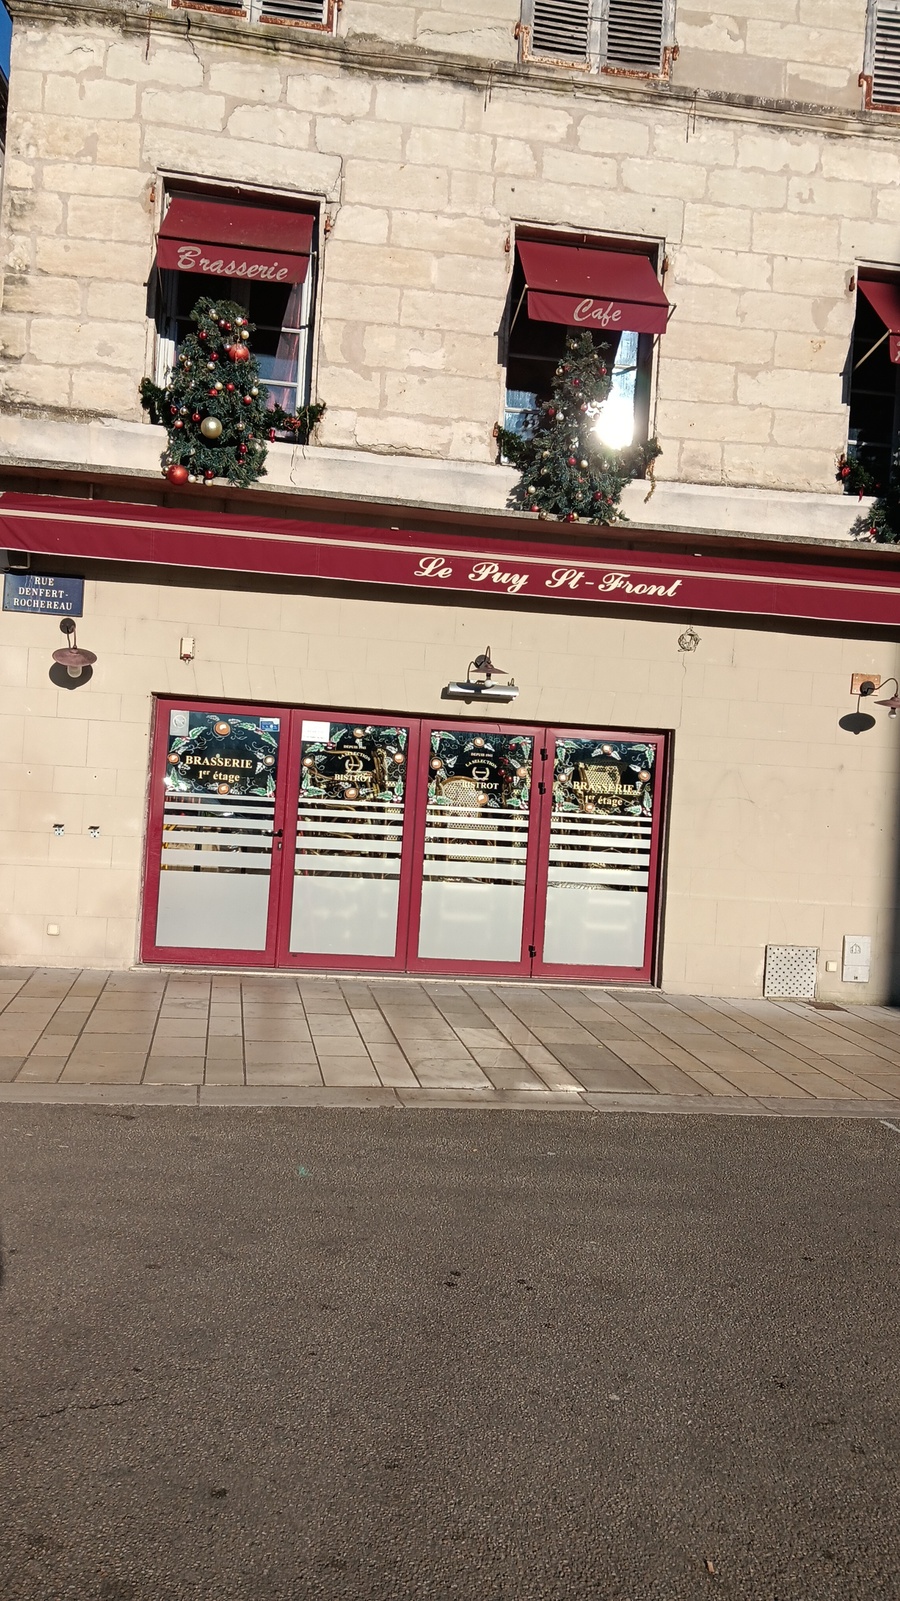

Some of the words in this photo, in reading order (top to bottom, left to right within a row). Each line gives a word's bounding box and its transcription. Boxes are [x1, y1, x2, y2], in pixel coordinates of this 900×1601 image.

[177, 245, 289, 280] Brasserie
[573, 298, 622, 327] Cafe
[34, 576, 55, 586] RUE
[413, 556, 452, 579] Le
[468, 562, 529, 593] Puy
[545, 568, 683, 598] St-Front
[18, 586, 69, 599] DENFERT-
[13, 597, 73, 611] ROCHEREAU
[185, 755, 253, 769] BRASSERIE
[471, 758, 498, 769] SELECTION
[212, 770, 240, 784] étage
[334, 773, 372, 783] BISTROT
[573, 781, 634, 795] BRASSERIE
[597, 796, 623, 808] étage
